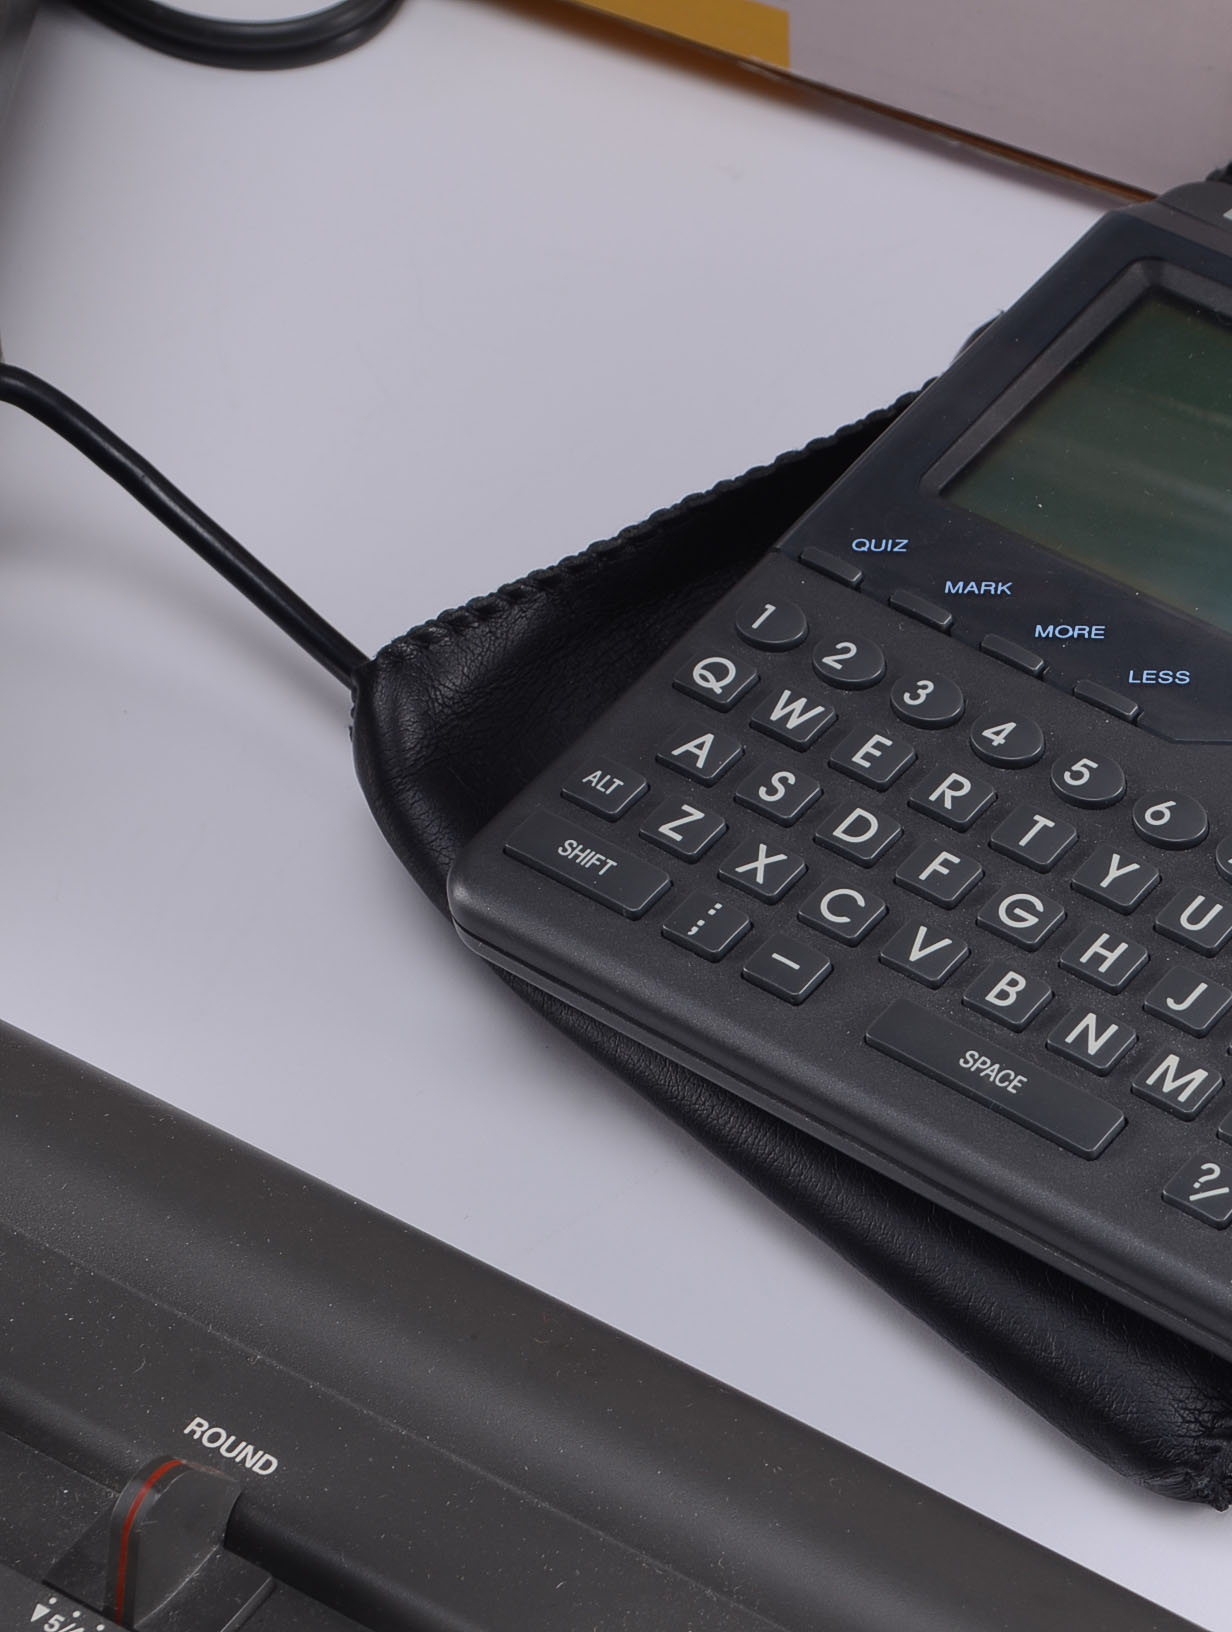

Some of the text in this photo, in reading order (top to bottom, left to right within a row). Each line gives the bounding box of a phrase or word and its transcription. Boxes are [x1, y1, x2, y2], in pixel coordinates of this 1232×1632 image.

[851, 538, 909, 552] QUIZ
[944, 581, 1013, 595] MARK
[751, 603, 776, 629] 1
[1034, 624, 1106, 639] MORE
[821, 641, 857, 670] 2
[692, 656, 736, 694] Q
[1128, 670, 1190, 685] LESS
[769, 689, 825, 729] W
[903, 680, 935, 706] 3
[671, 733, 715, 769] A
[851, 734, 893, 768] E
[981, 722, 1017, 746] 4
[582, 770, 625, 795] ALT
[758, 771, 796, 802] S
[1063, 758, 1099, 786] 5
[928, 772, 972, 810] R
[658, 804, 705, 842] Z
[832, 807, 879, 843] D
[1018, 814, 1056, 847] T
[1144, 800, 1177, 826] 6
[557, 839, 618, 876] SHIFT
[735, 843, 787, 884] X
[918, 851, 961, 881] F
[1099, 853, 1141, 888] Y
[820, 888, 866, 923] C
[998, 893, 1044, 928] G
[1179, 895, 1224, 931] U
[909, 925, 953, 962] V
[1079, 933, 1129, 973] H
[985, 971, 1026, 1007] B
[1166, 982, 1208, 1011] J
[1064, 1012, 1118, 1055] N
[959, 1050, 1028, 1094] SPACE
[1145, 1054, 1208, 1102] M
[183, 1416, 278, 1475] ROUND
